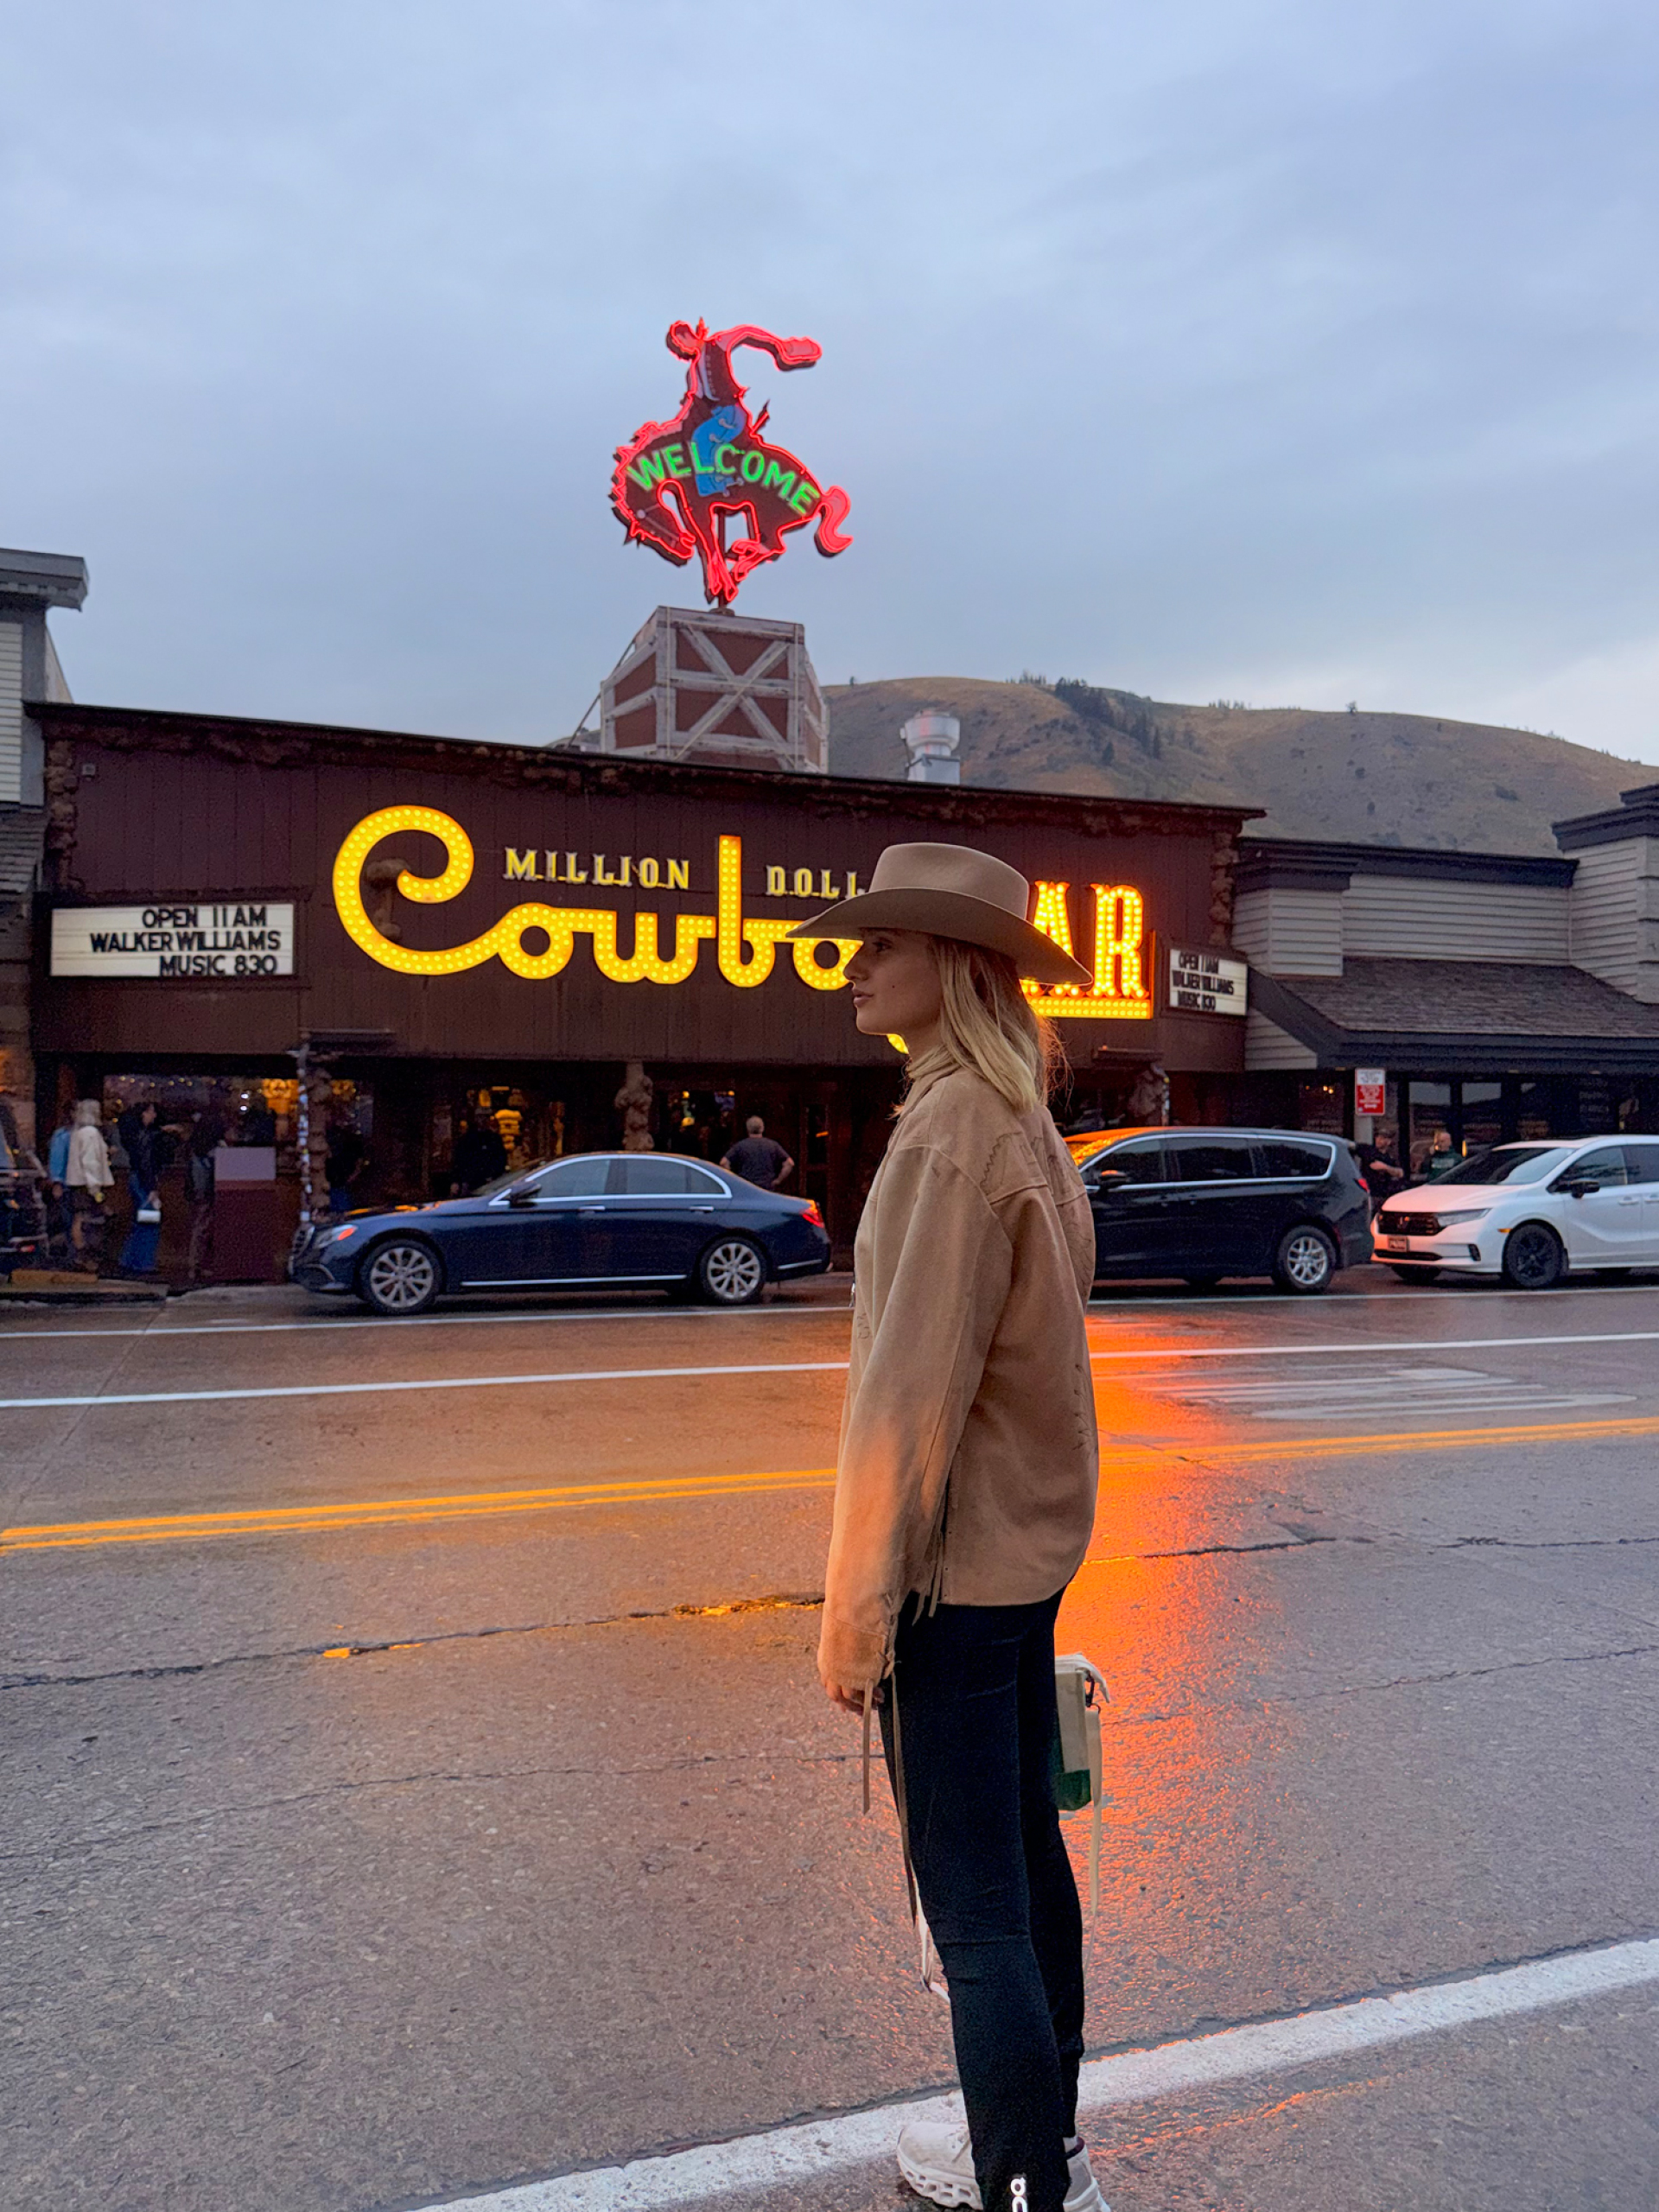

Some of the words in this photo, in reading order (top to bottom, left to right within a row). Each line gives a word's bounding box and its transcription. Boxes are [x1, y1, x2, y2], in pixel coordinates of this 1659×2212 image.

[627, 442, 821, 516] WELCOME
[332, 804, 866, 992] Cowbo
[503, 846, 690, 890] MILLION
[766, 865, 866, 899] DOLL
[90, 931, 173, 953] WALKER
[176, 930, 282, 951] WILLIAMS
[142, 908, 198, 929] OPEN
[1020, 880, 1150, 1000] AR
[160, 954, 226, 976] MUSIC
[233, 954, 278, 975] 830
